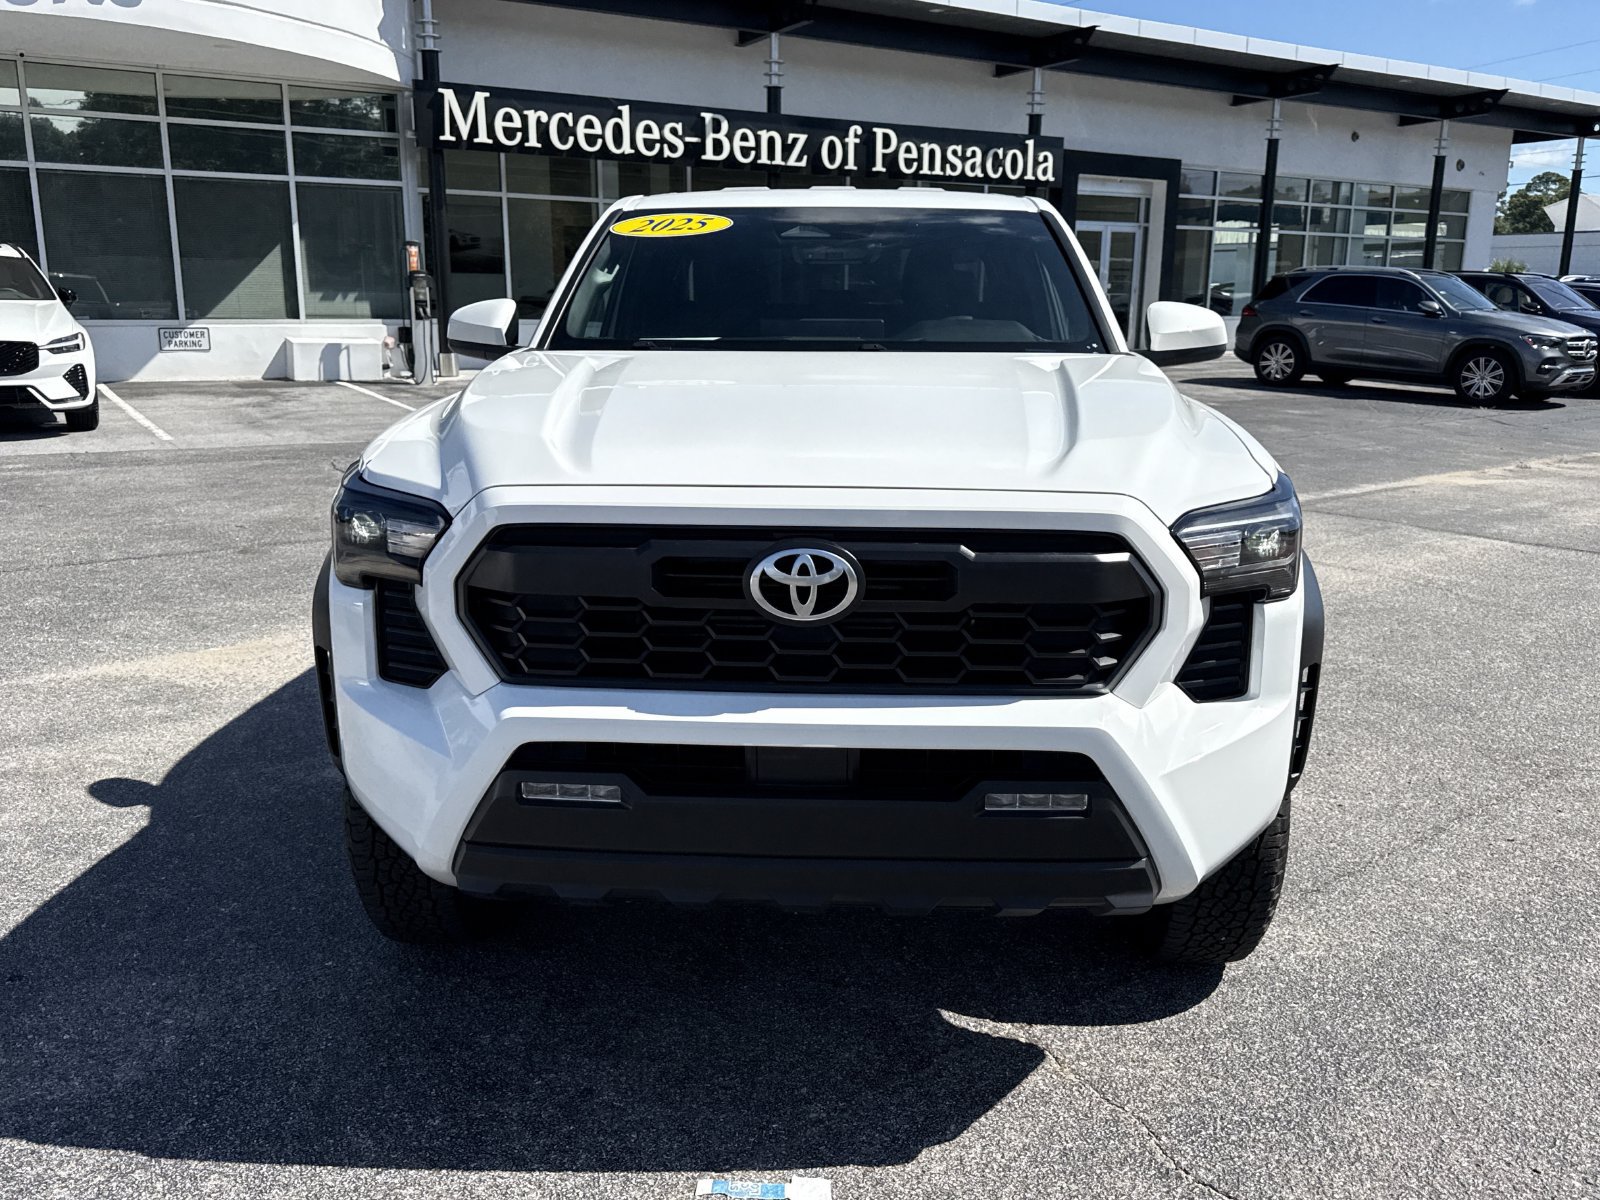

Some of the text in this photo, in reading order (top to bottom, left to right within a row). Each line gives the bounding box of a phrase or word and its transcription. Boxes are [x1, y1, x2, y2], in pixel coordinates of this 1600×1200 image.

[438, 87, 1055, 182] Mercedes-Benz of Pensacola
[628, 217, 715, 232] 2025
[163, 330, 206, 339] CUSTOMER
[167, 339, 203, 348] PARKING
